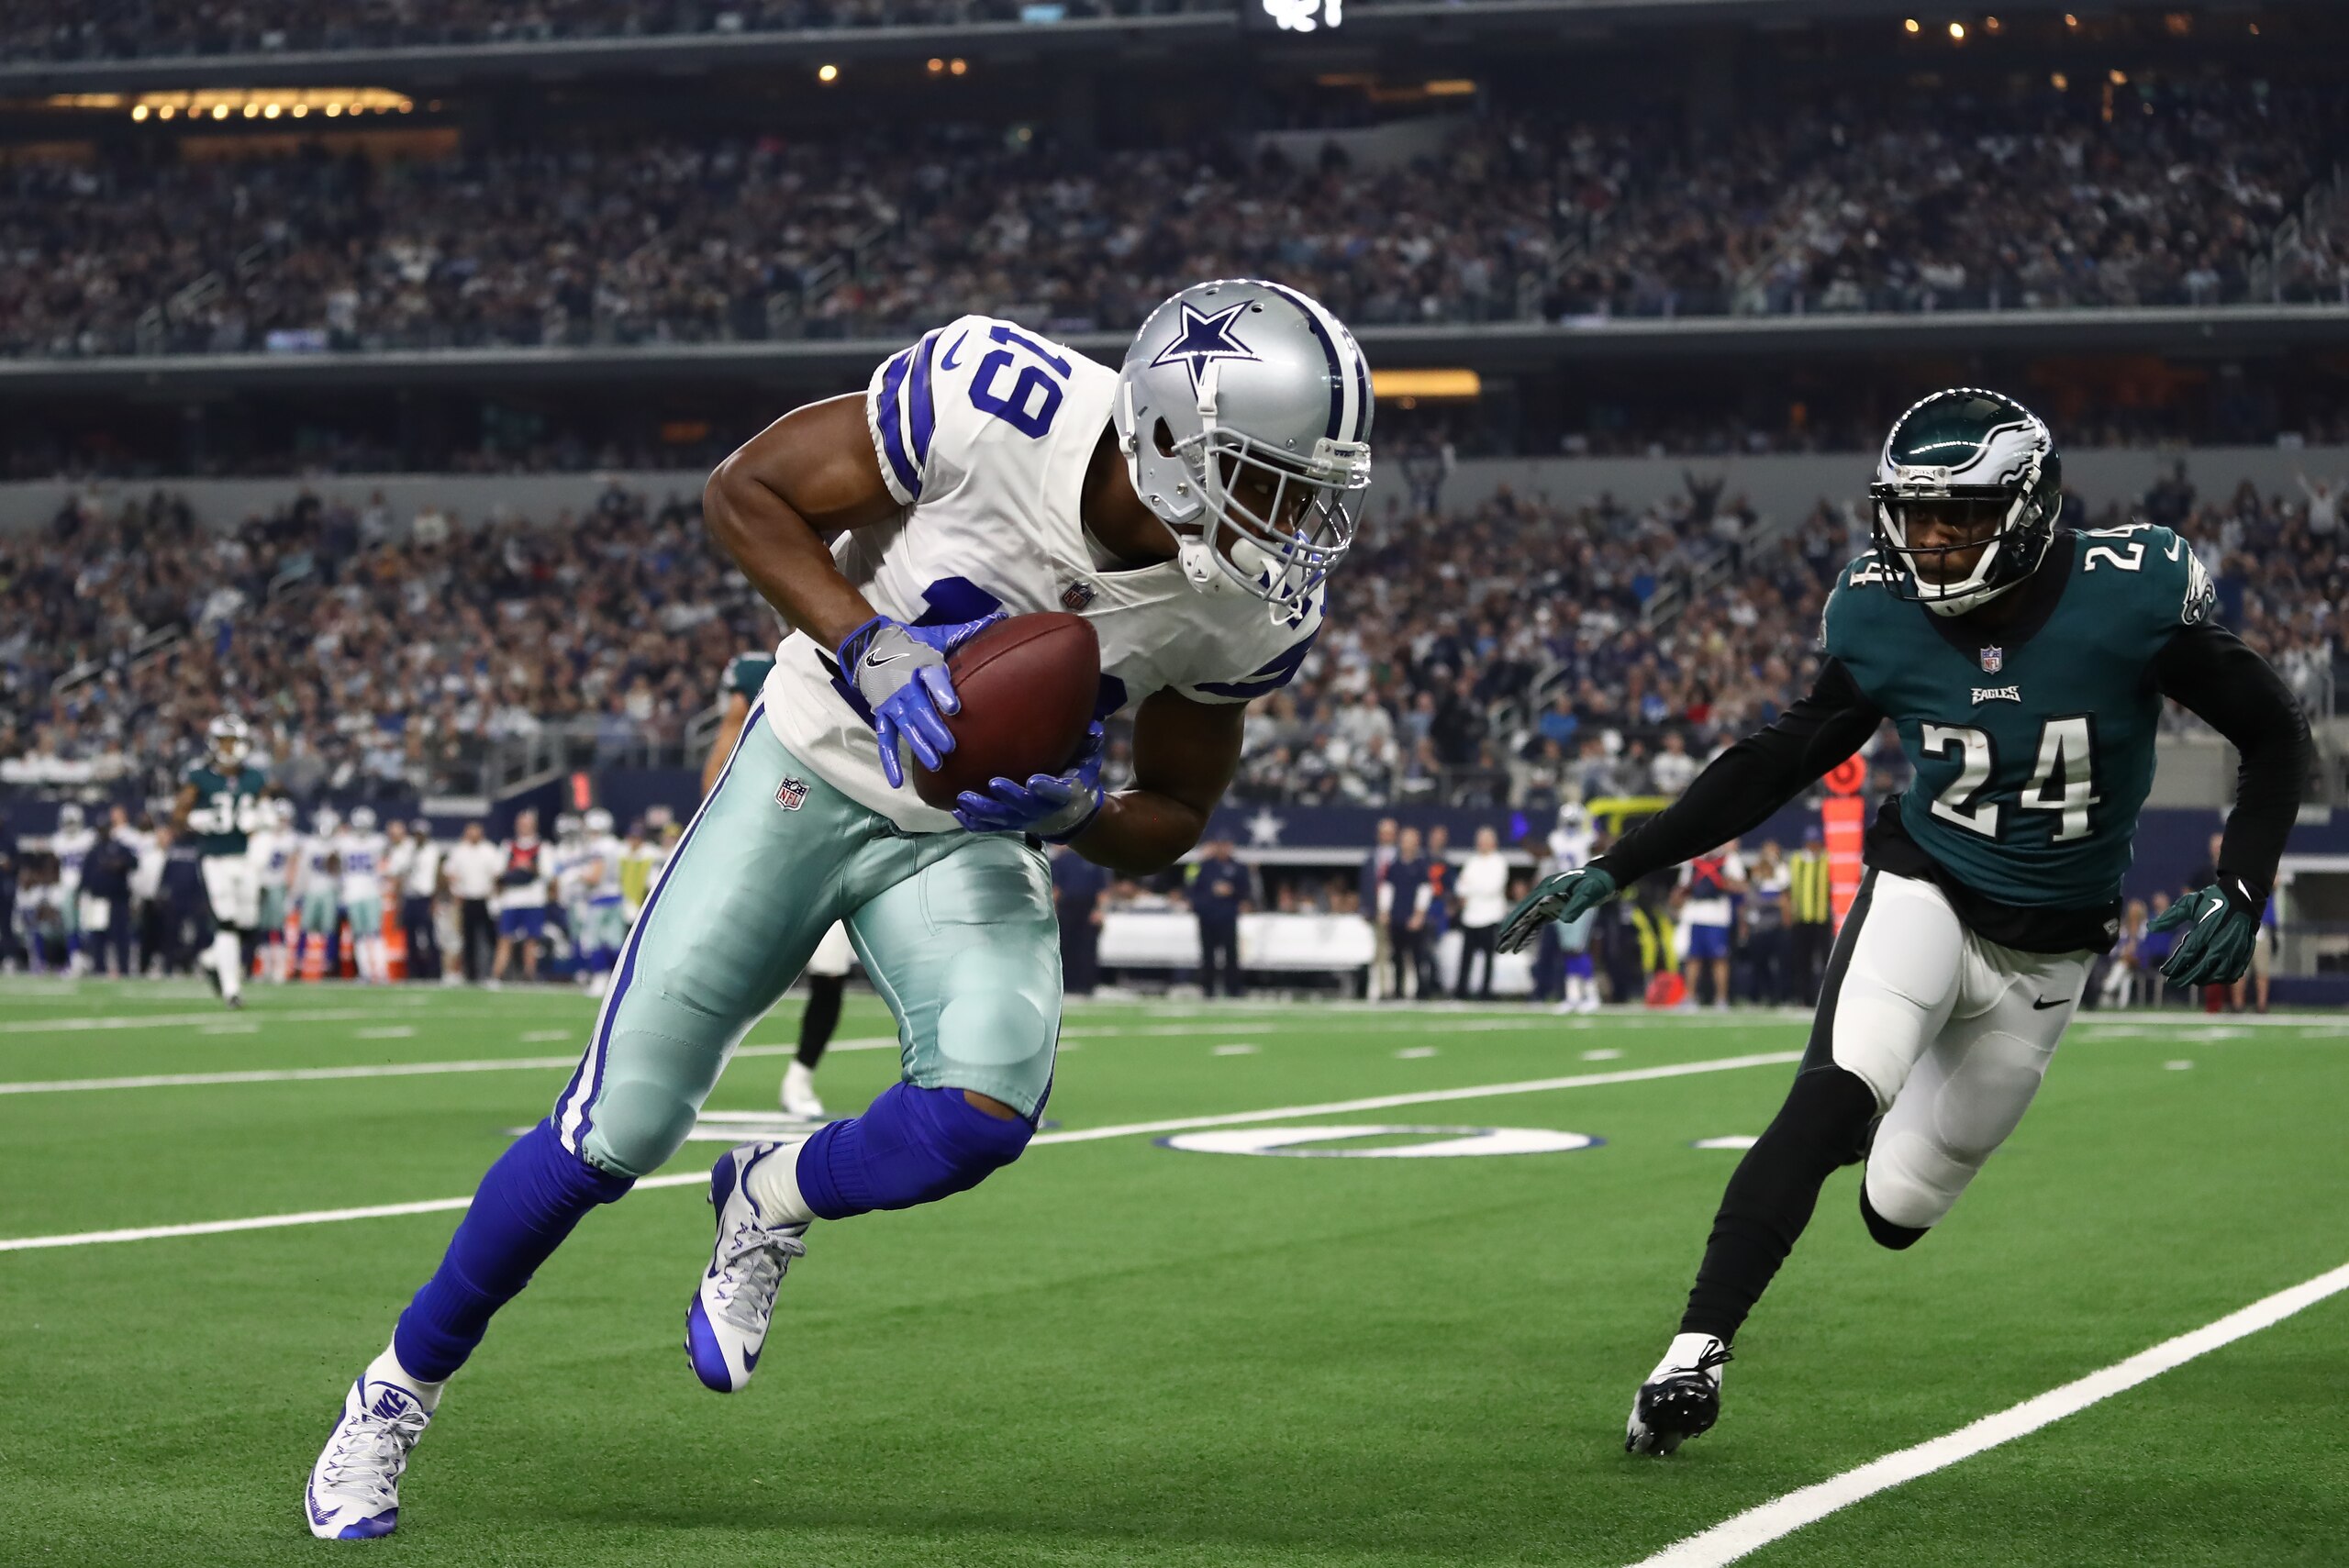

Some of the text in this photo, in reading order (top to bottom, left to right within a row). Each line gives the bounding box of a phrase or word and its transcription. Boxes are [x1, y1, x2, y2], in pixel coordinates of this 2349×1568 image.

[968, 326, 1072, 439] 19
[1849, 549, 1906, 586] 4
[1983, 658, 1999, 671] NFL
[1970, 685, 2021, 706] EAGLES
[1920, 717, 2101, 842] 24
[778, 787, 800, 806] NFL
